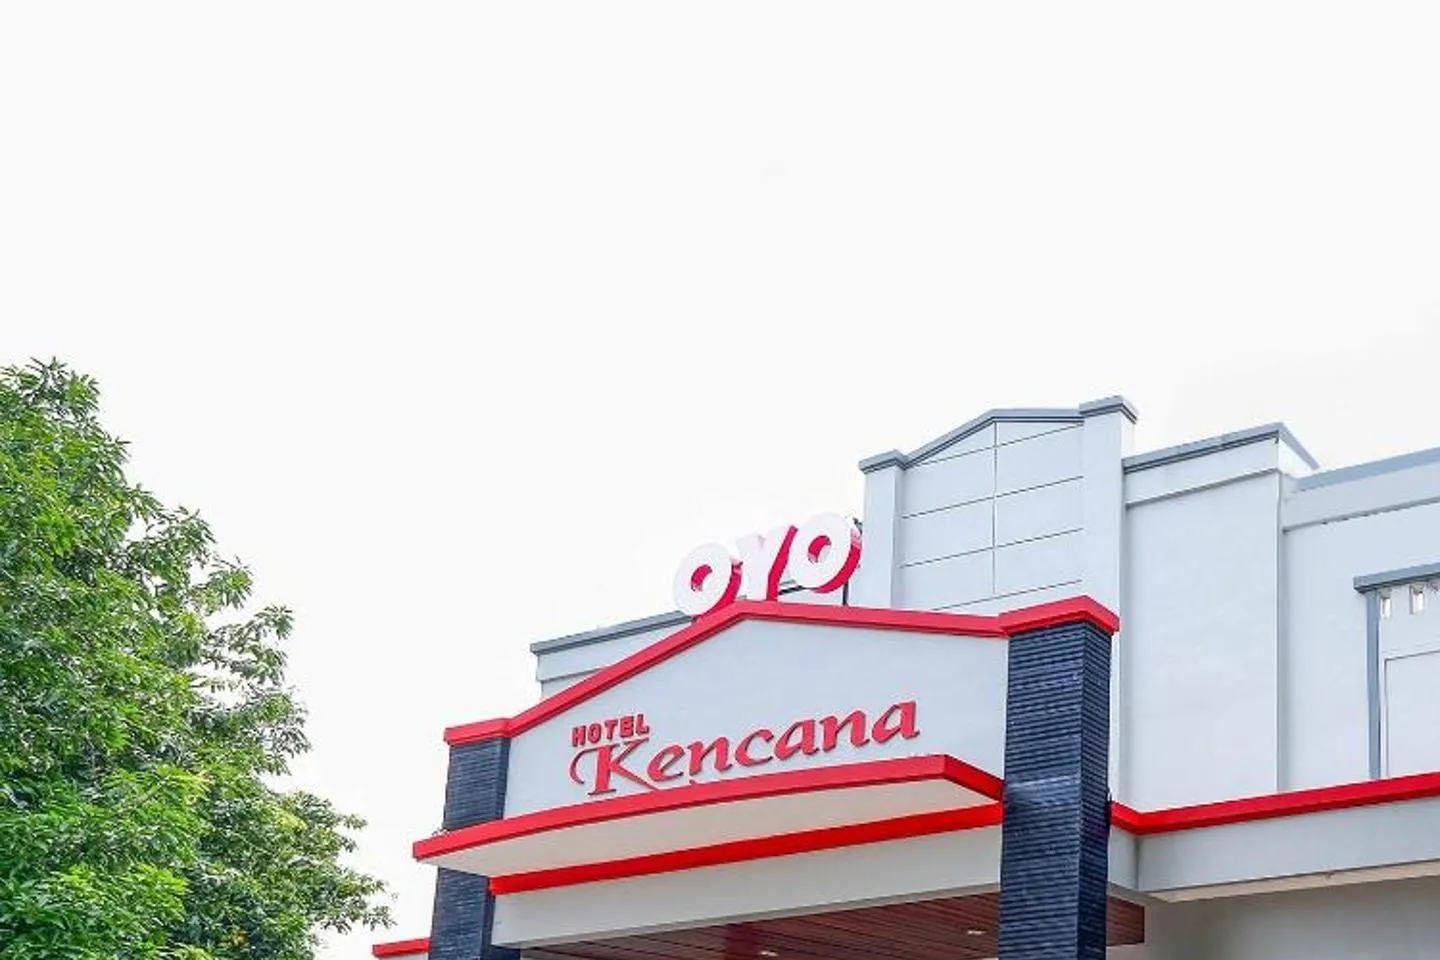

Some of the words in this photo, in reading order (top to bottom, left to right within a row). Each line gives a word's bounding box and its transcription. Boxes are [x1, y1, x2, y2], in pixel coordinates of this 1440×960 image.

[674, 512, 861, 620] OYO
[569, 700, 920, 796] Kencana
[571, 713, 650, 747] HOTEL
